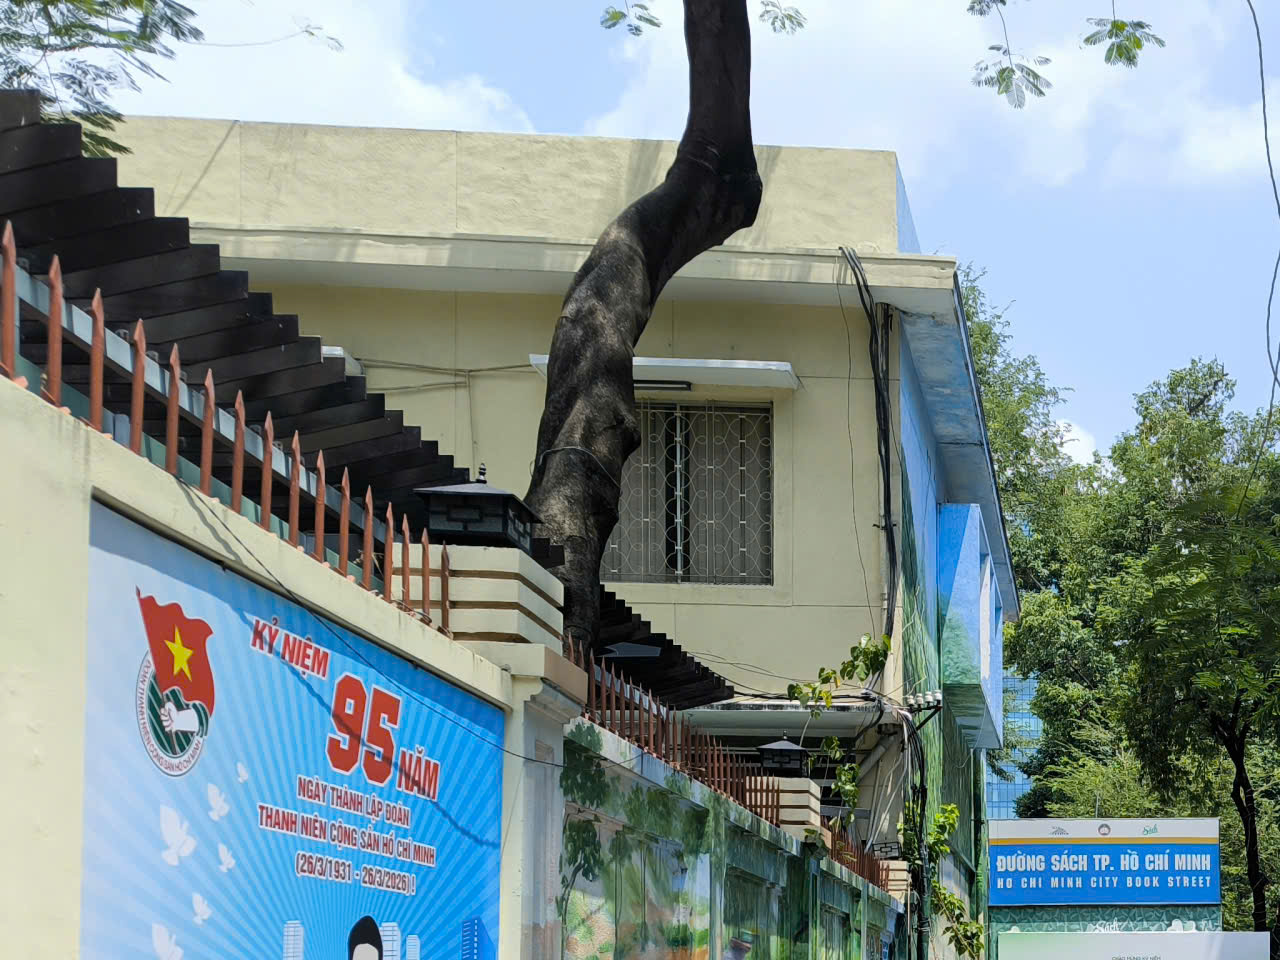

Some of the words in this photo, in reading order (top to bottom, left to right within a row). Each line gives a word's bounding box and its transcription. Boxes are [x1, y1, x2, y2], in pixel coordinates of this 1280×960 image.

[251, 616, 281, 654] KỶ
[281, 633, 330, 678] NIỆM
[326, 674, 402, 787] 95
[397, 746, 440, 800] NĂM
[297, 775, 328, 803] NGÀY
[330, 784, 363, 812] THÀNH
[365, 793, 383, 822] LẬP
[384, 802, 410, 827] ĐOÀN
[258, 804, 298, 834] THANH
[301, 813, 328, 841] NIÊN
[329, 819, 358, 850] CỘNG
[360, 825, 380, 852] SẢN
[397, 837, 411, 860] CHÍ
[413, 843, 436, 865] MINH
[996, 850, 1045, 872] ĐƯỜNG
[1051, 850, 1088, 872] SÁCH
[1093, 854, 1114, 871] TP.
[1120, 849, 1139, 871] HỒ
[1145, 850, 1169, 871] CHÍ
[1174, 854, 1211, 870] MINH
[296, 853, 352, 881] (26/3/1931
[997, 877, 1013, 889] HO
[1021, 877, 1042, 888] CHI
[1051, 877, 1083, 888] MINH
[1090, 876, 1118, 888] CITY
[1126, 876, 1160, 887] BOOK
[1168, 876, 1211, 887] STREET
